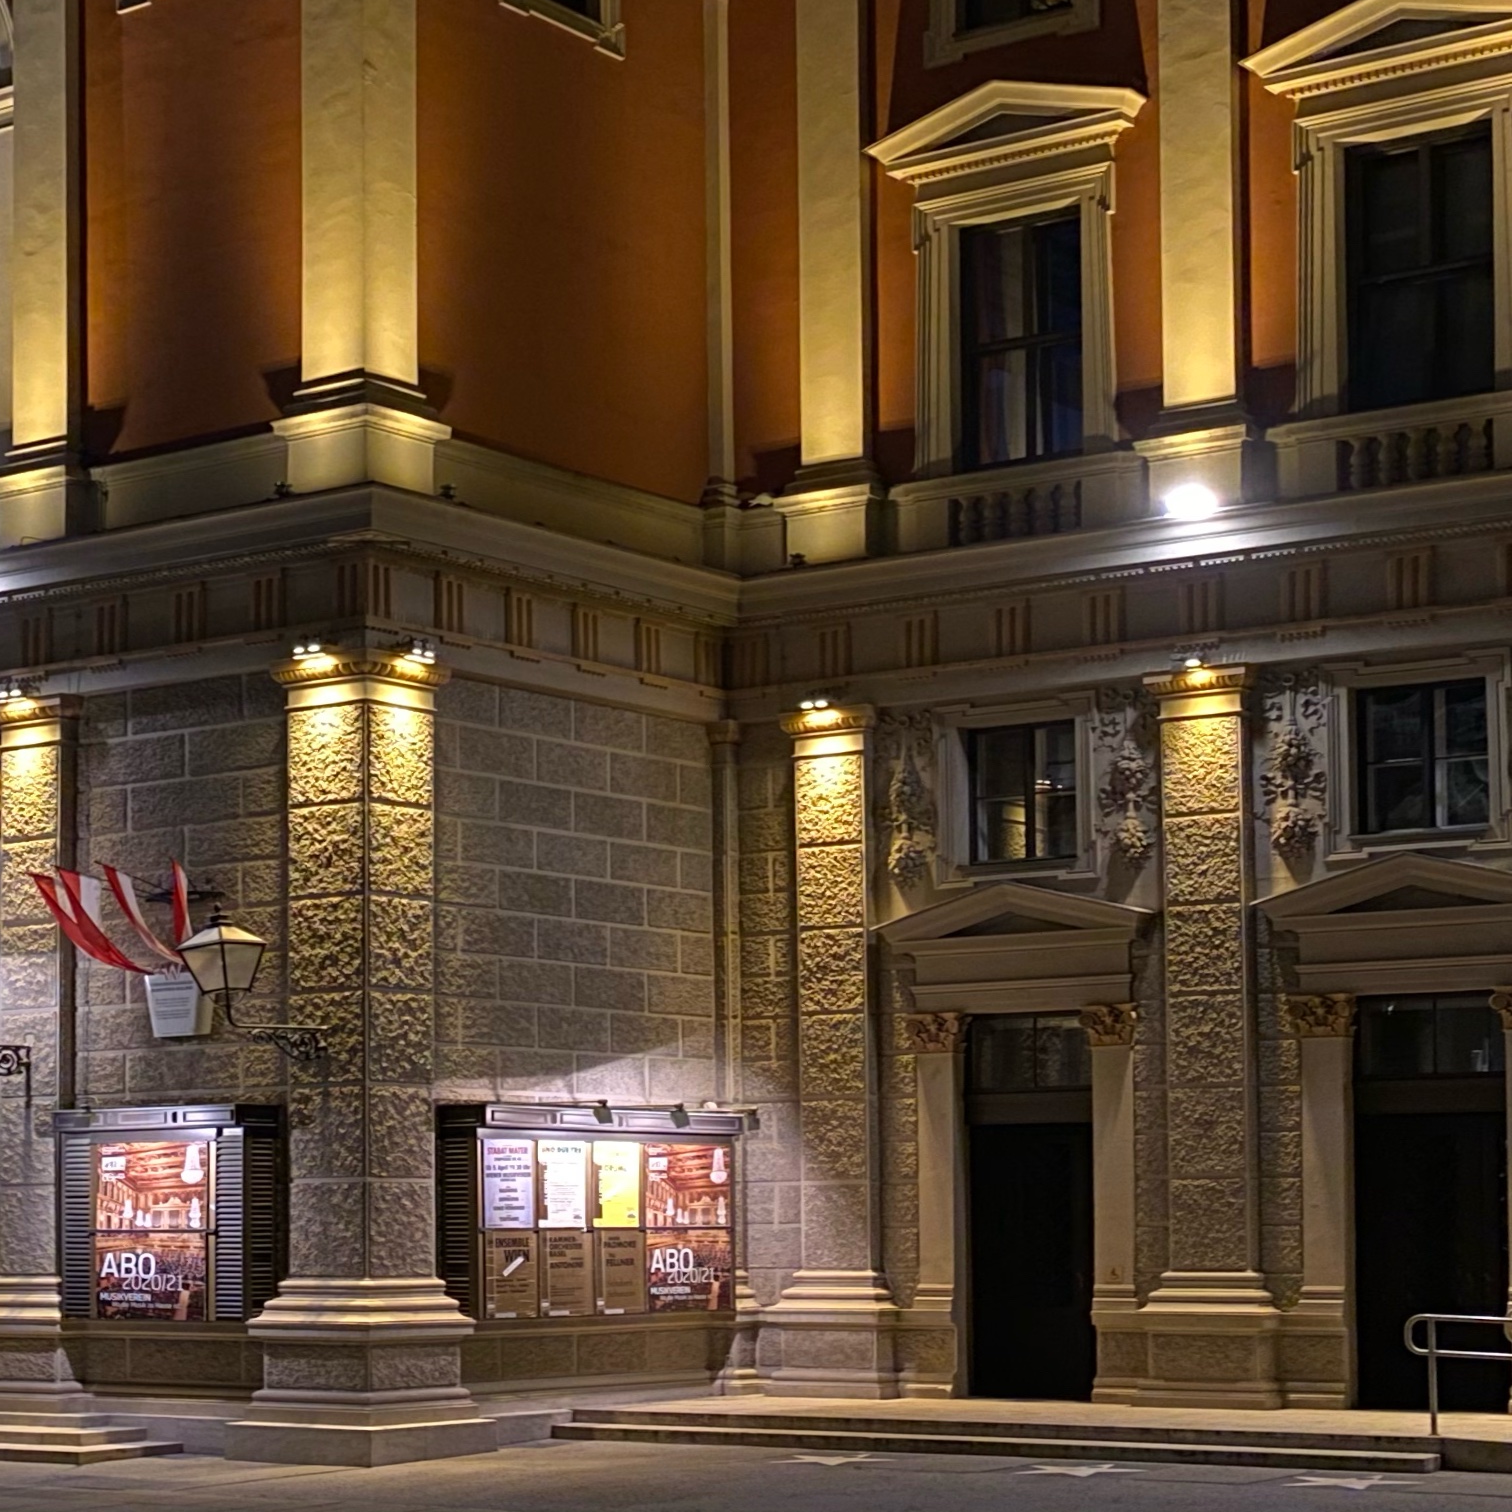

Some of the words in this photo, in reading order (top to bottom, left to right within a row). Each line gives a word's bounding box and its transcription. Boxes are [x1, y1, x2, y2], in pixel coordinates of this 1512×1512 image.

[495, 1237, 530, 1248] ENSEMBLE
[100, 1252, 156, 1278] ABO
[650, 1248, 694, 1273] ABO
[122, 1274, 185, 1292] 2020/21
[667, 1267, 716, 1284] 2020/21
[99, 1291, 152, 1302] MUSIKVEREIN
